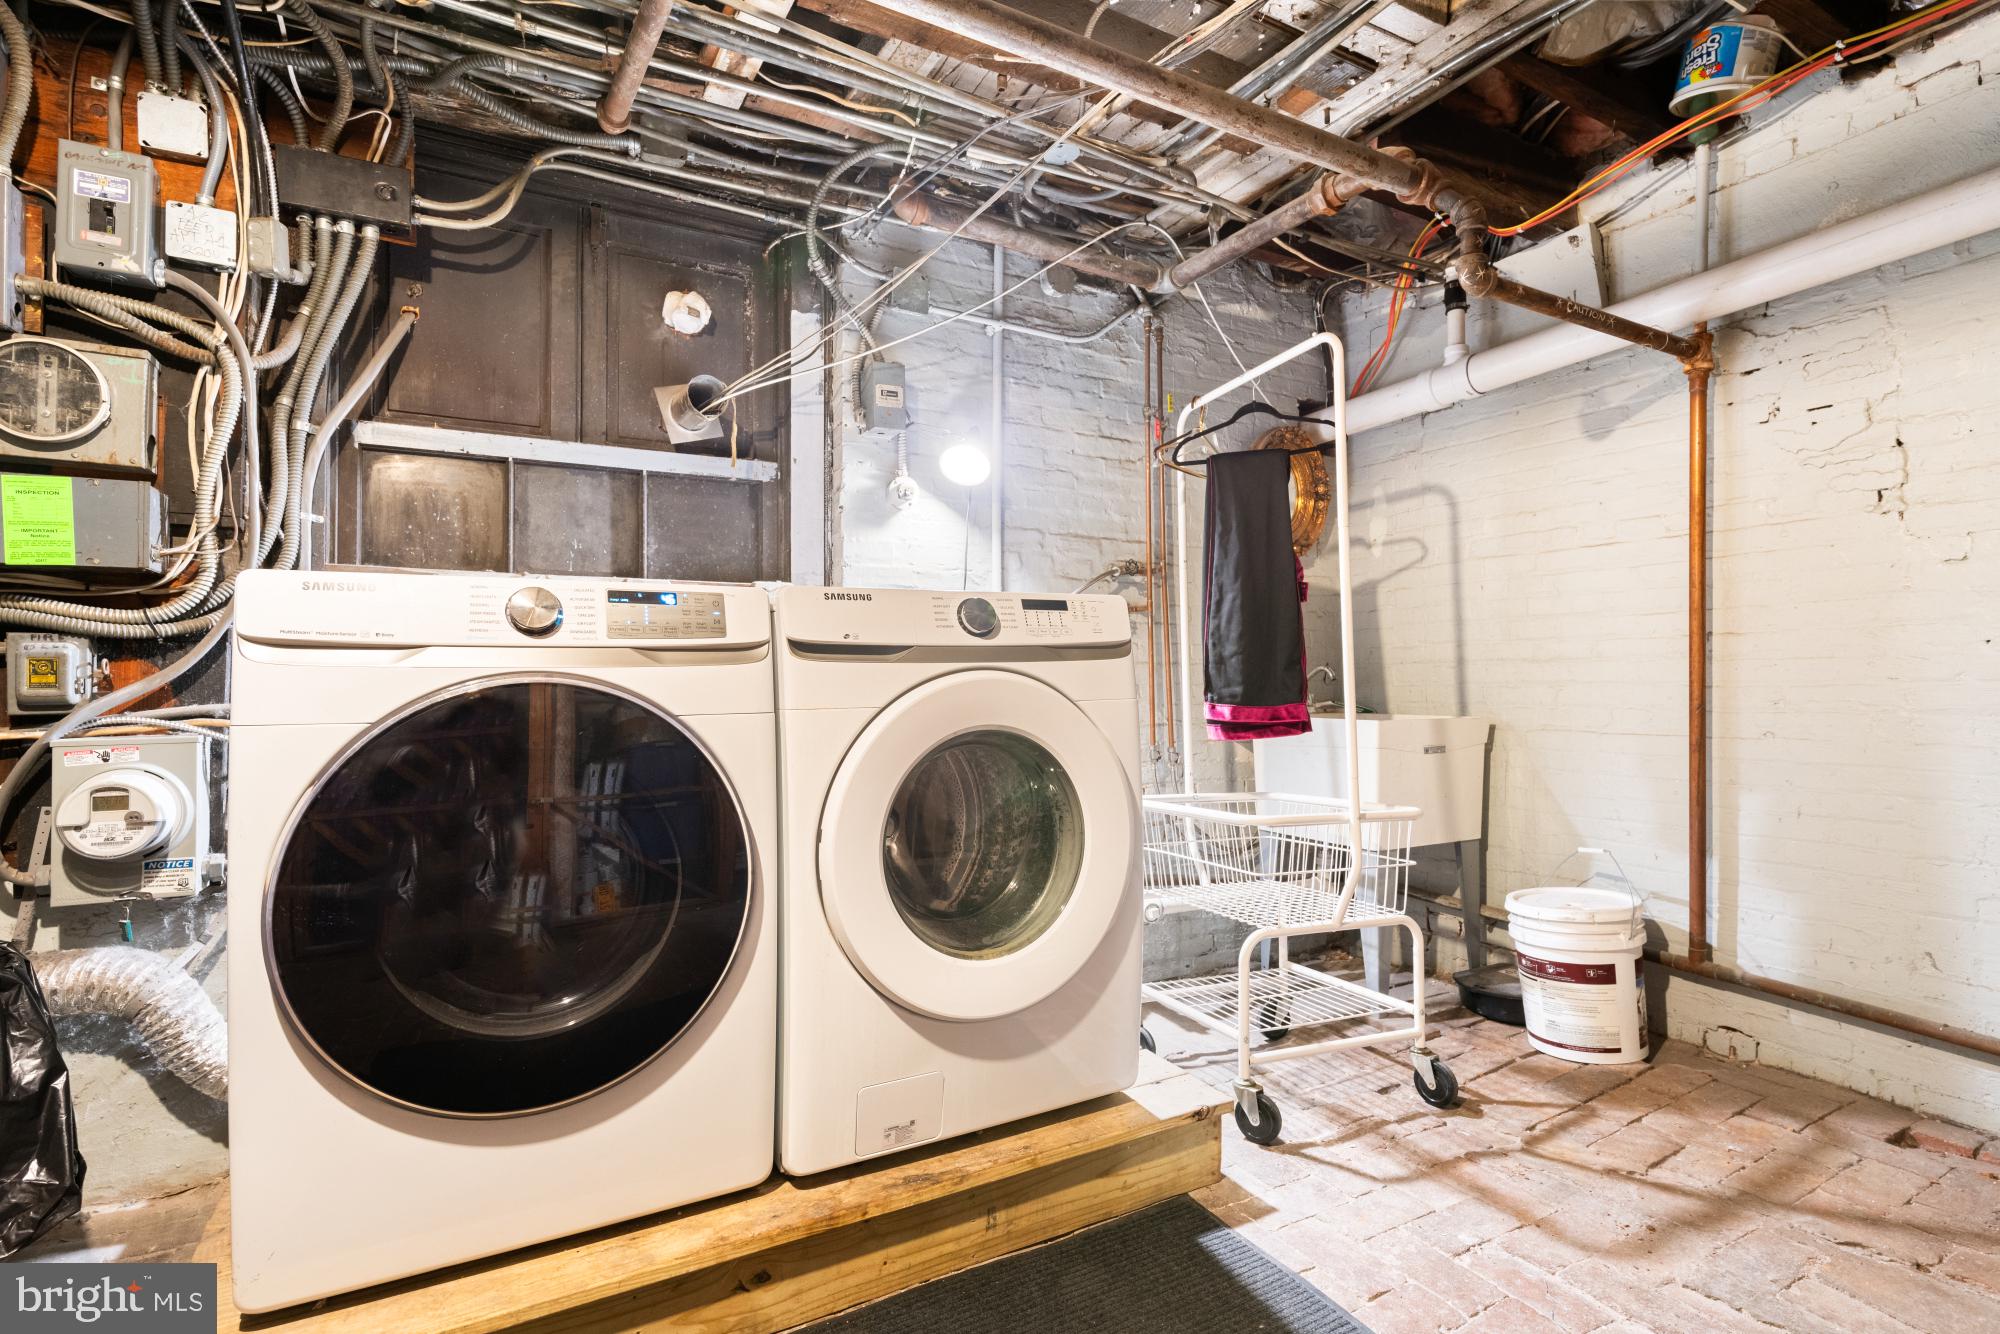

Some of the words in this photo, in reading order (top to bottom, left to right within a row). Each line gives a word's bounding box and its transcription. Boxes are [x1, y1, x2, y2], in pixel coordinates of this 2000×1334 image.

[1567, 301, 1606, 321] CAUTION
[301, 581, 377, 592] SAMSUNG
[823, 592, 873, 601] SAMSUNG
[149, 860, 190, 869] NOTICE
